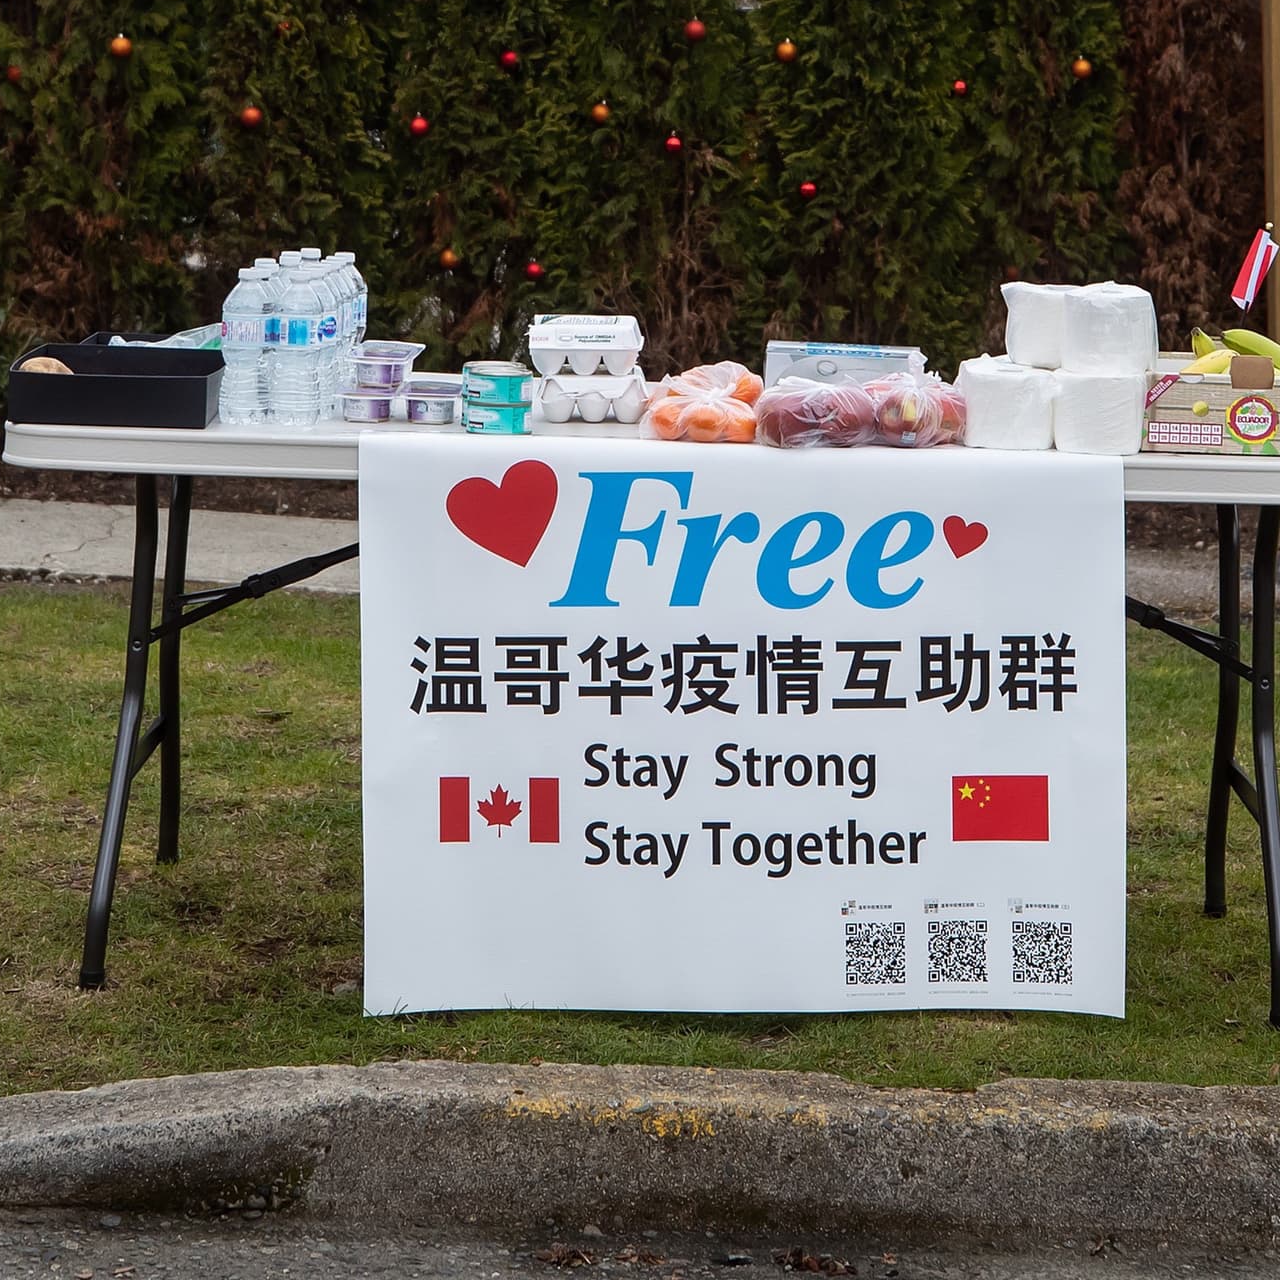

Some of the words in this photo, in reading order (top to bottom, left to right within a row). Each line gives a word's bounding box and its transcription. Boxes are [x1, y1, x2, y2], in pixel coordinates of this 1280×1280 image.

[1237, 415, 1270, 424] ECUADOR
[548, 470, 934, 610] Free
[409, 632, 1078, 716] 温哥华疫情互助群
[583, 743, 689, 801] Stay
[714, 742, 878, 799] Strong
[584, 821, 690, 879] Stay
[702, 819, 927, 879] Together
